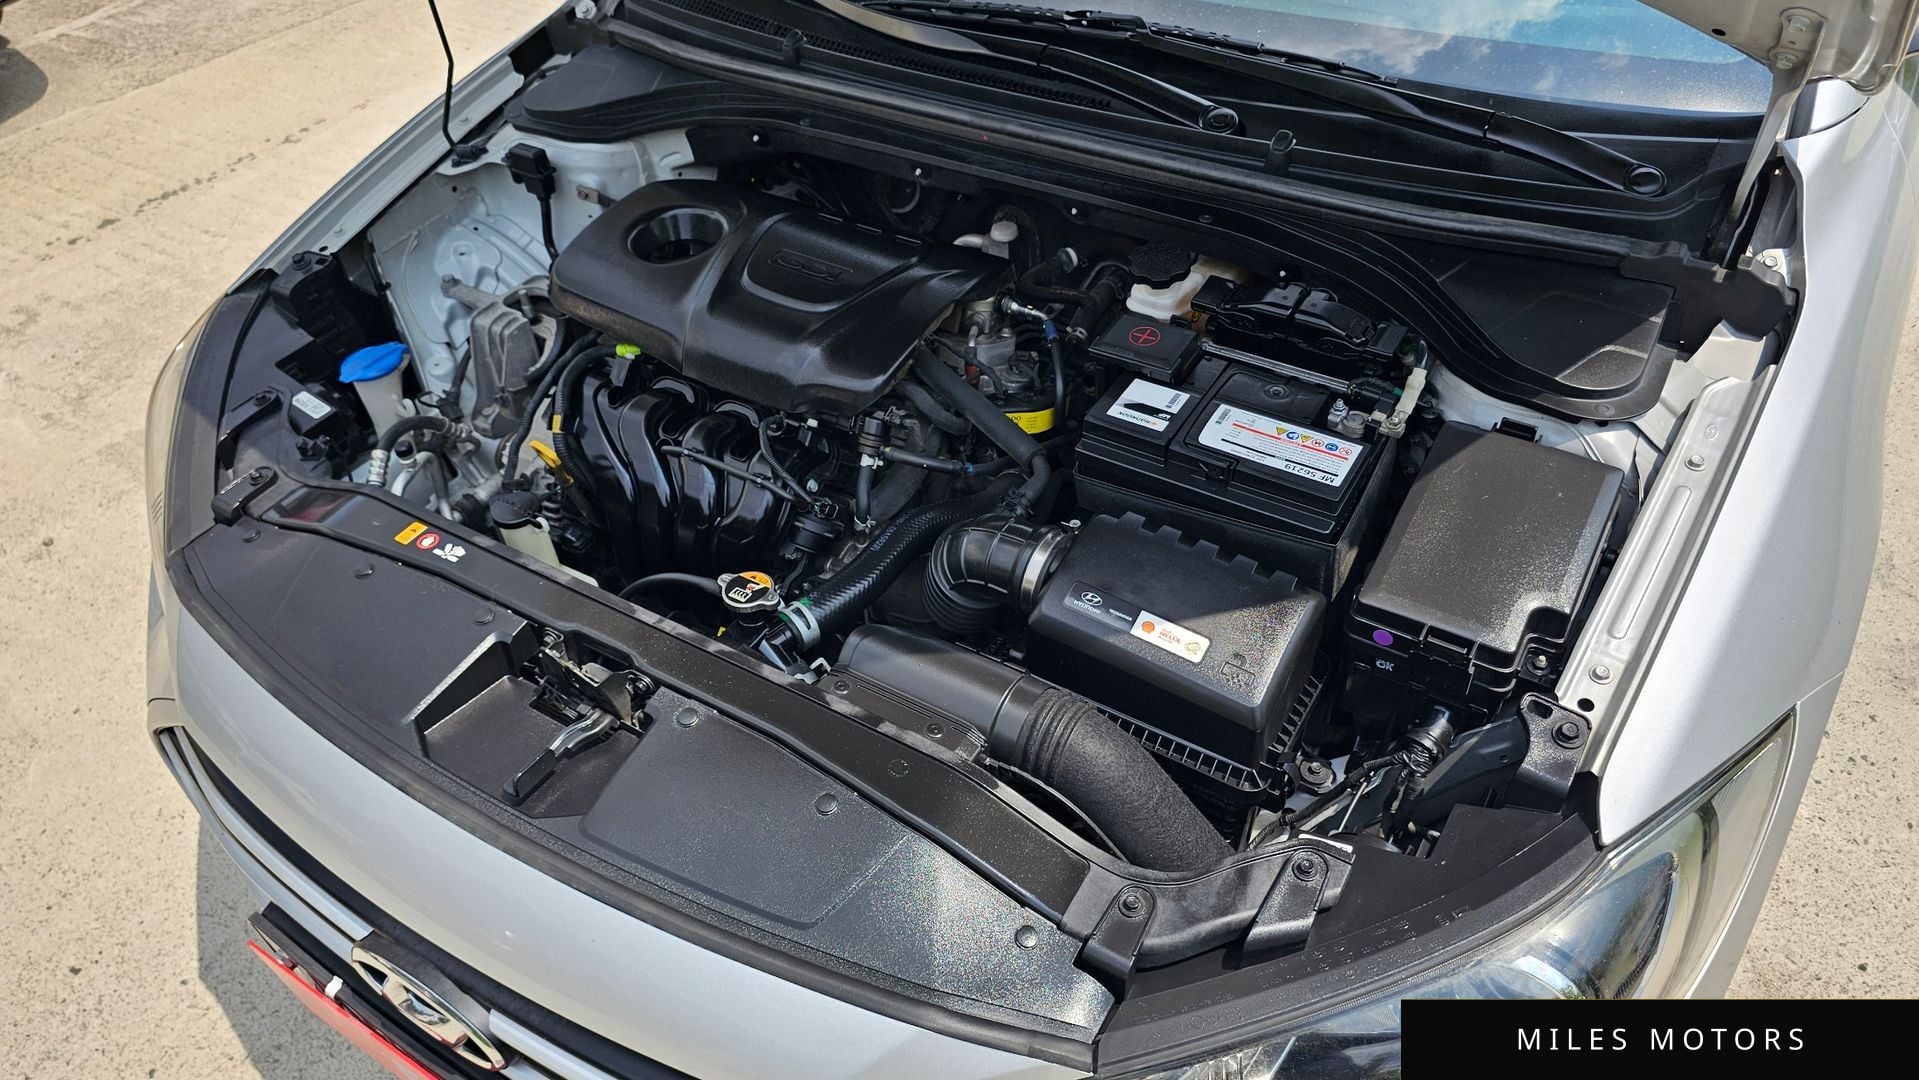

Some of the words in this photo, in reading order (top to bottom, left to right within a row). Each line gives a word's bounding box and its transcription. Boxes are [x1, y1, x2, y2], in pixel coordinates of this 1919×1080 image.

[1285, 463, 1317, 480] 56219
[1317, 474, 1335, 484] MF
[1073, 600, 1101, 614] HYUNDAI
[1375, 659, 1395, 672] OK
